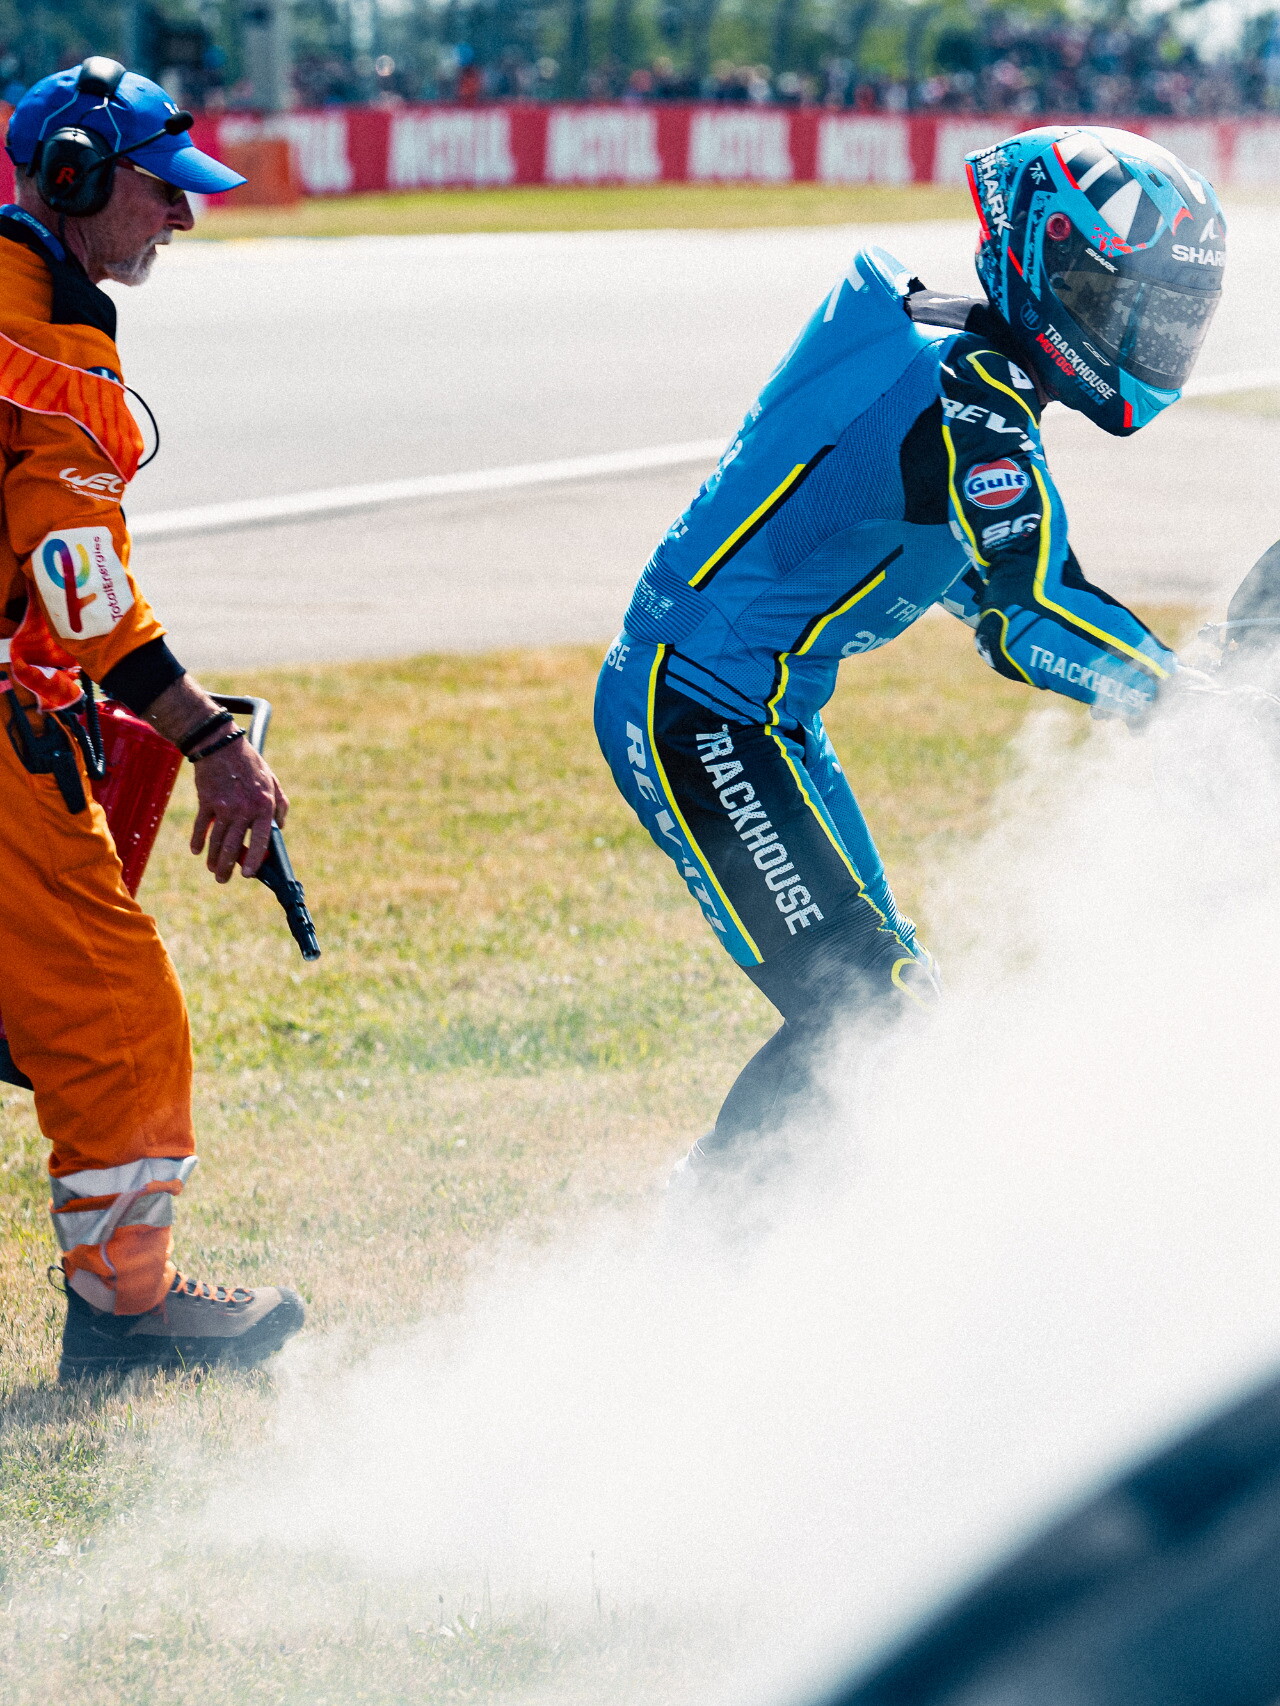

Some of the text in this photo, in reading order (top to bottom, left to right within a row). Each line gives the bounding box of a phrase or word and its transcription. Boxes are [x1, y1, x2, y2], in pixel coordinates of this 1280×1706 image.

[1085, 248, 1118, 274] SHARK
[1044, 323, 1118, 400] TRACKHOUSE
[967, 473, 1026, 495] Gulf
[92, 535, 124, 623] TotalEnergies
[695, 723, 824, 936] TRACKHOUSE
